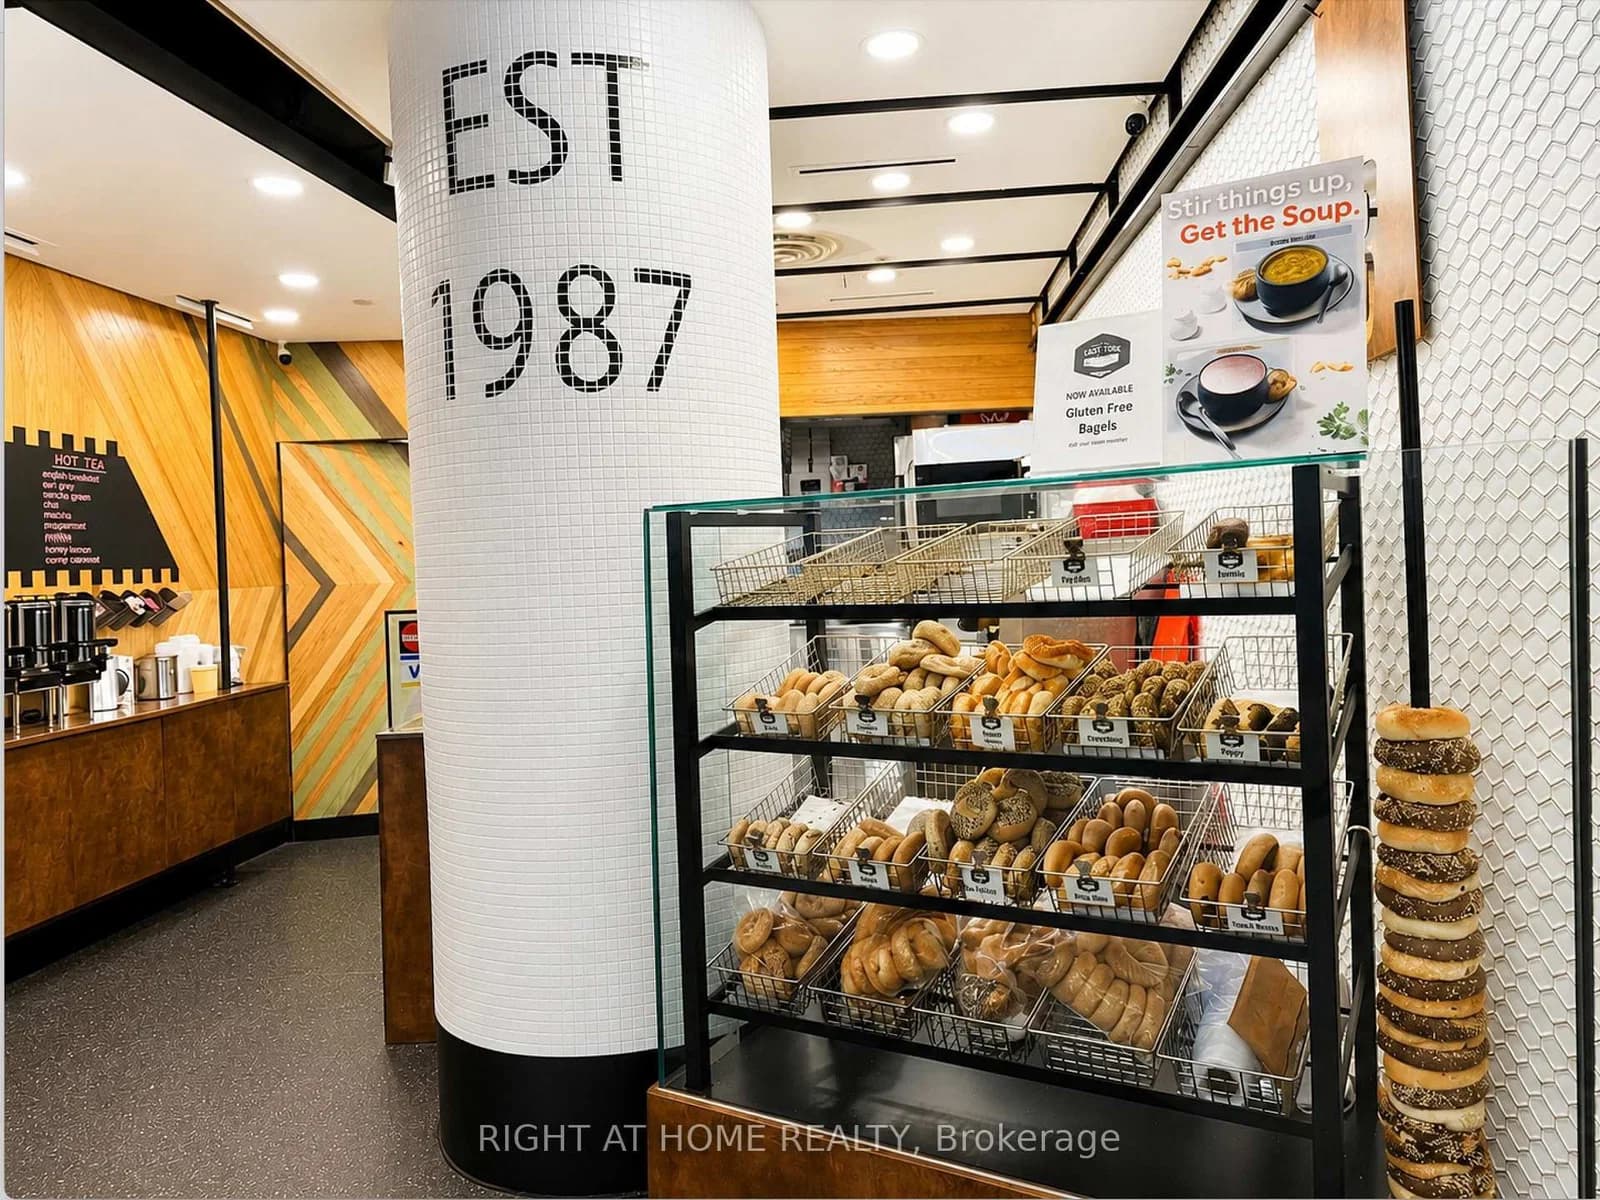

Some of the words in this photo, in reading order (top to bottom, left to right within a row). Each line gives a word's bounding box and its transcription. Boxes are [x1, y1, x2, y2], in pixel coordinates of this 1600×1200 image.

[442, 51, 648, 195] EST
[1167, 198, 1212, 220] Stir
[1217, 181, 1301, 211] things
[1308, 173, 1353, 197] up,
[1180, 219, 1227, 245] Get
[1231, 213, 1276, 237] the
[1282, 199, 1361, 227] Soup.
[431, 264, 692, 401] 1987
[1065, 390, 1087, 401] NOW
[1088, 383, 1134, 398] AVAILABLE
[1065, 406, 1104, 419] Gluten
[1107, 402, 1134, 414] Free
[1078, 419, 1118, 436] Bagels
[54, 454, 79, 467] HOT
[84, 457, 105, 470] TEA
